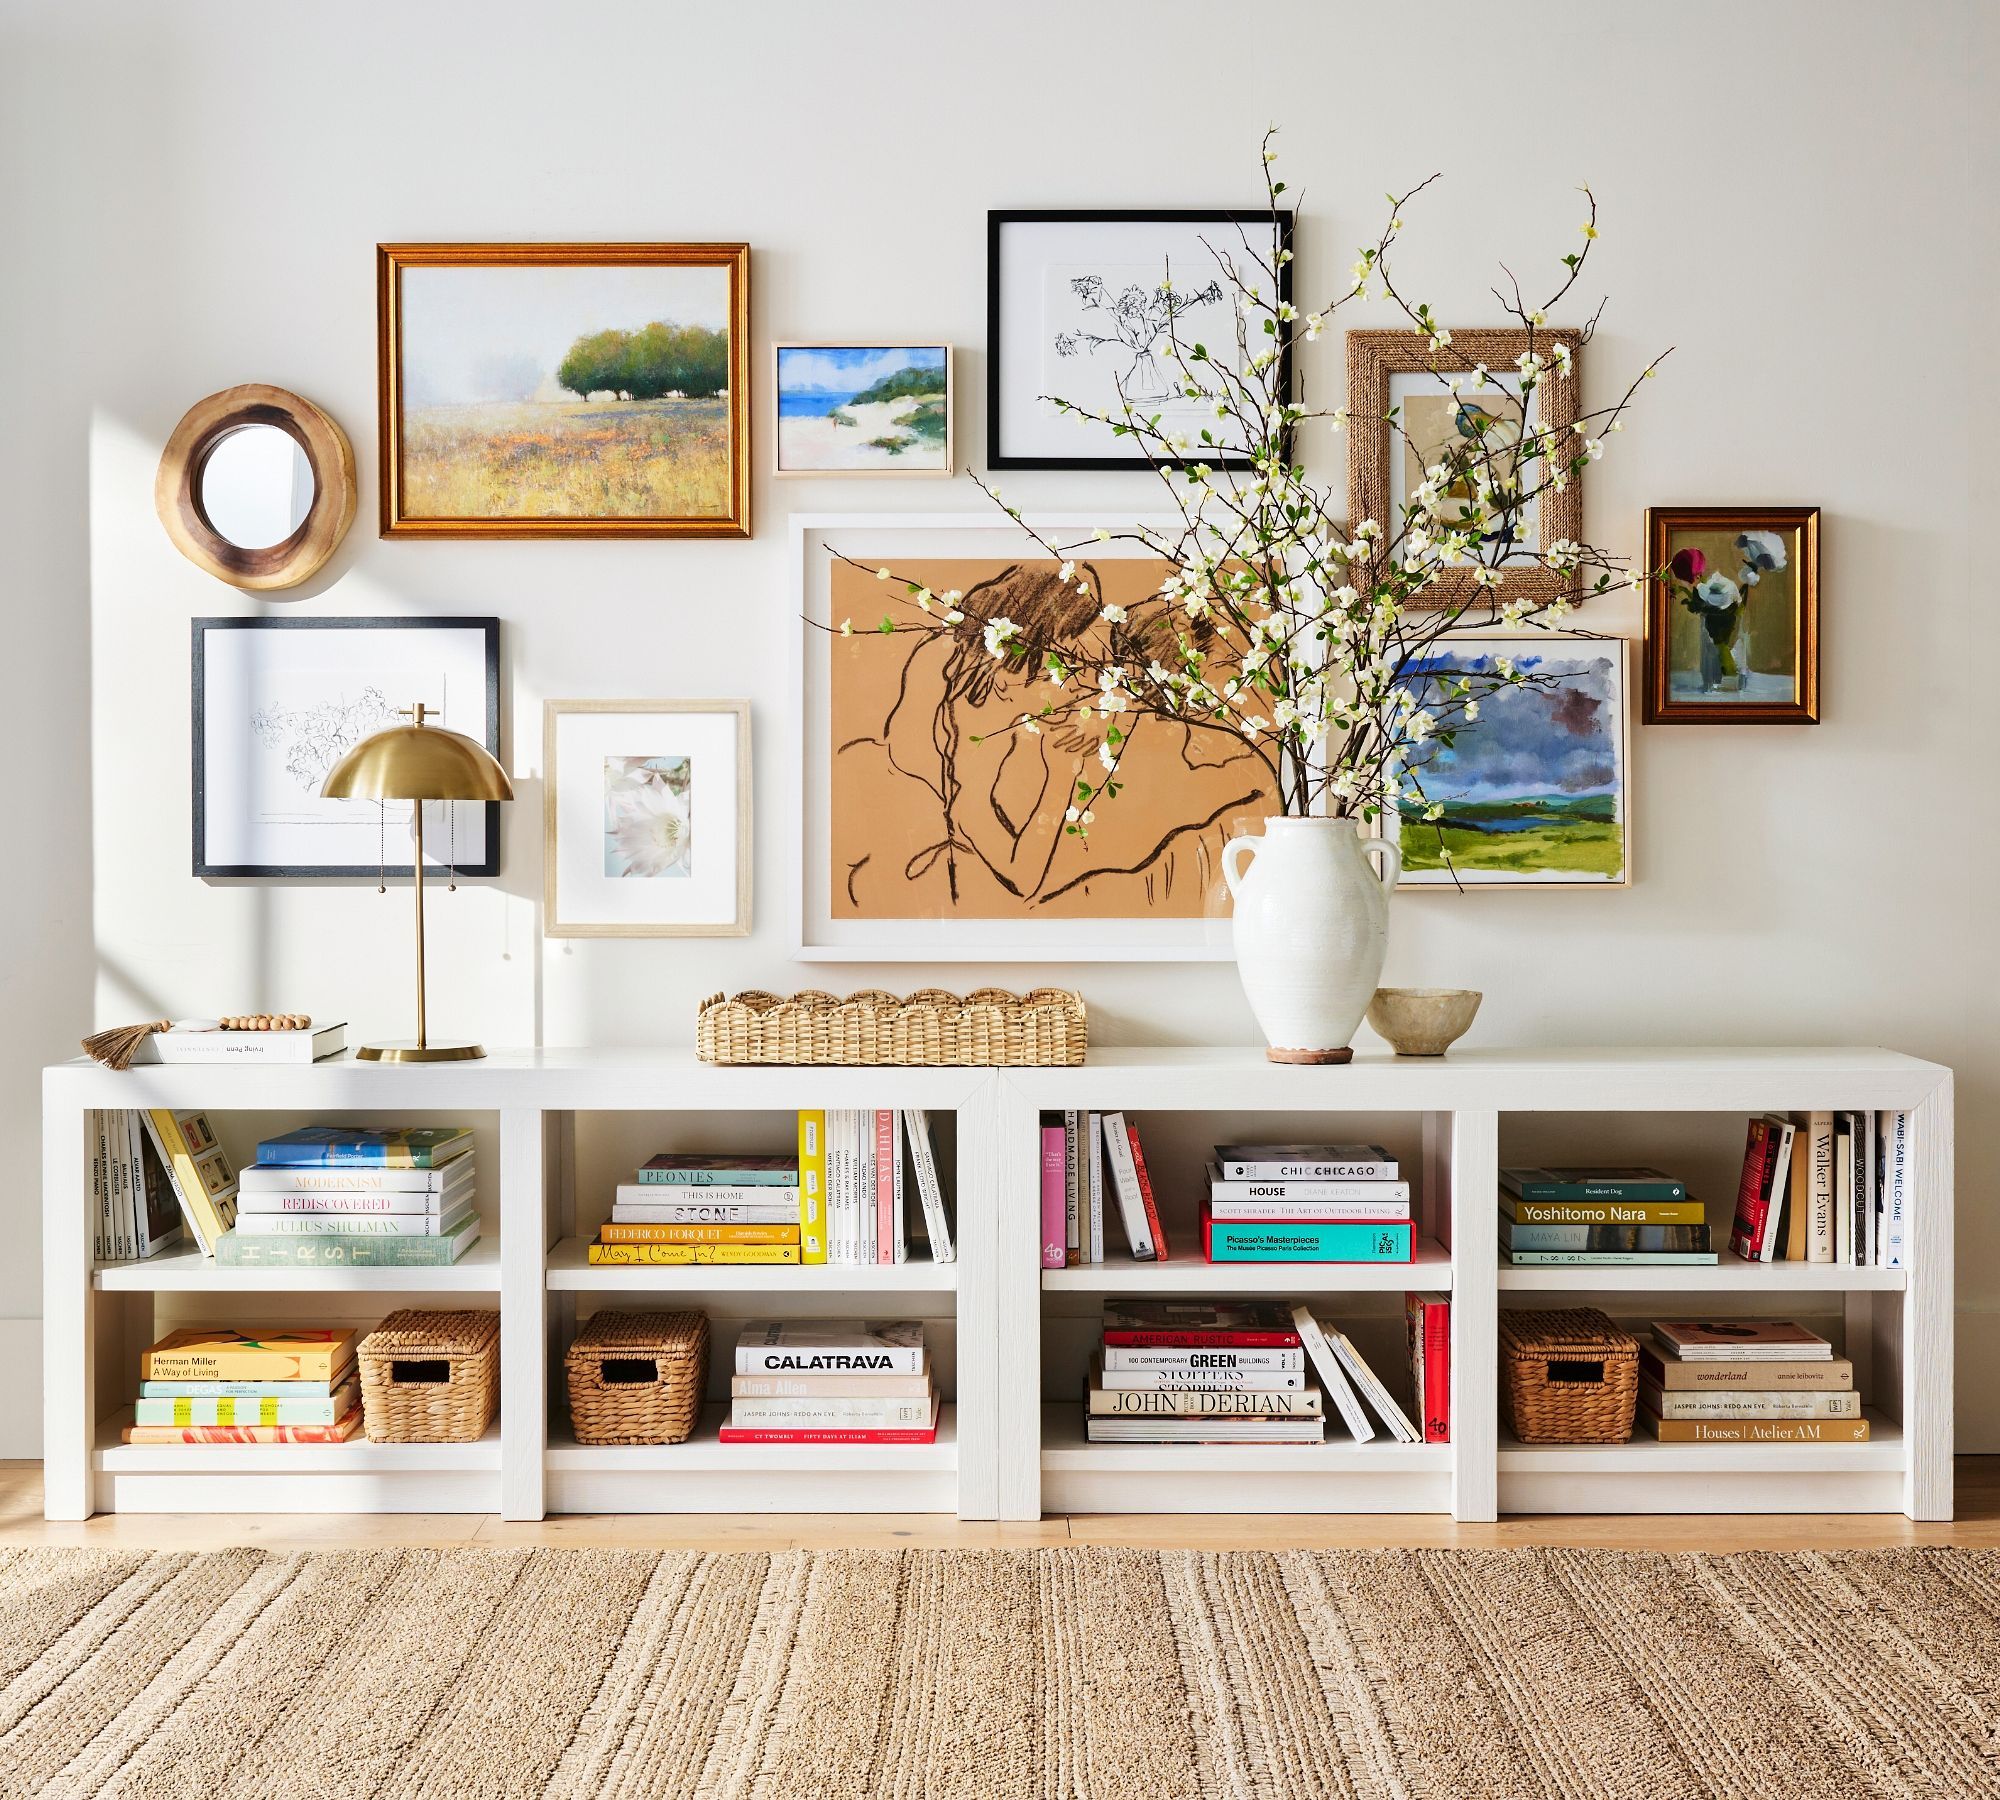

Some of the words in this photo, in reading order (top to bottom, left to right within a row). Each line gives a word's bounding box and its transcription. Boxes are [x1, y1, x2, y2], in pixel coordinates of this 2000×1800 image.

[1896, 1113, 1905, 1166] WABI-SABI
[879, 1112, 890, 1182] DAHLIAS
[1816, 1134, 1830, 1187] Walker
[295, 1177, 382, 1188] MODERNISM
[646, 1172, 714, 1182] PEONIES
[917, 1169, 926, 1188] LLOYD
[924, 1151, 934, 1178] SANTIAGO
[929, 1179, 939, 1209] CALATRAVA
[1249, 1187, 1285, 1196] HOUSE
[1856, 1158, 1864, 1215] WOODCUT
[682, 1191, 704, 1200] THIS
[705, 1192, 714, 1200] IS
[716, 1192, 744, 1200] HOME
[1894, 1169, 1903, 1221] WELCOME
[283, 1199, 390, 1210] REDISCOVERED
[1142, 1192, 1156, 1220] BEAUTY
[675, 1208, 739, 1221] STONE
[1524, 1206, 1606, 1221] Yoshitomo
[1611, 1207, 1646, 1221] Nara
[1816, 1192, 1829, 1236] Evans
[271, 1221, 322, 1232] JULIUS
[327, 1221, 399, 1232] SHULMAN
[610, 1229, 666, 1239] FEDERICO
[669, 1229, 722, 1241] FORQUET
[1226, 1236, 1265, 1244] Picasso's
[1266, 1236, 1320, 1245] Masterpieces
[1531, 1232, 1561, 1242] MAYA
[1564, 1232, 1581, 1242] LIN
[242, 1246, 371, 1260] HIRST
[596, 1245, 631, 1262] May
[633, 1246, 643, 1262] I
[648, 1245, 686, 1262] Come
[688, 1245, 716, 1262] In?
[1044, 1243, 1063, 1259] 40
[1133, 1335, 1187, 1344] AMERICAN
[1194, 1335, 1233, 1344] RUSTIC
[154, 1357, 189, 1365] Herman
[191, 1357, 216, 1365] Miller
[764, 1356, 893, 1369] CALATRAVA
[1190, 1354, 1236, 1368] GREEN
[153, 1368, 160, 1376] A
[162, 1368, 181, 1378] Way
[182, 1368, 191, 1376] of
[193, 1368, 219, 1378] Living
[1696, 1372, 1748, 1381] wonderland
[186, 1385, 223, 1395] DEGAS
[739, 1381, 768, 1395] Alma
[776, 1381, 807, 1395] Allen
[1113, 1393, 1178, 1412] JOHN
[1199, 1394, 1293, 1412] DERIAN
[1429, 1417, 1446, 1434] 40
[1696, 1425, 1740, 1439] Houses
[1750, 1425, 1794, 1439] Atelier
[1795, 1425, 1820, 1439] AM
